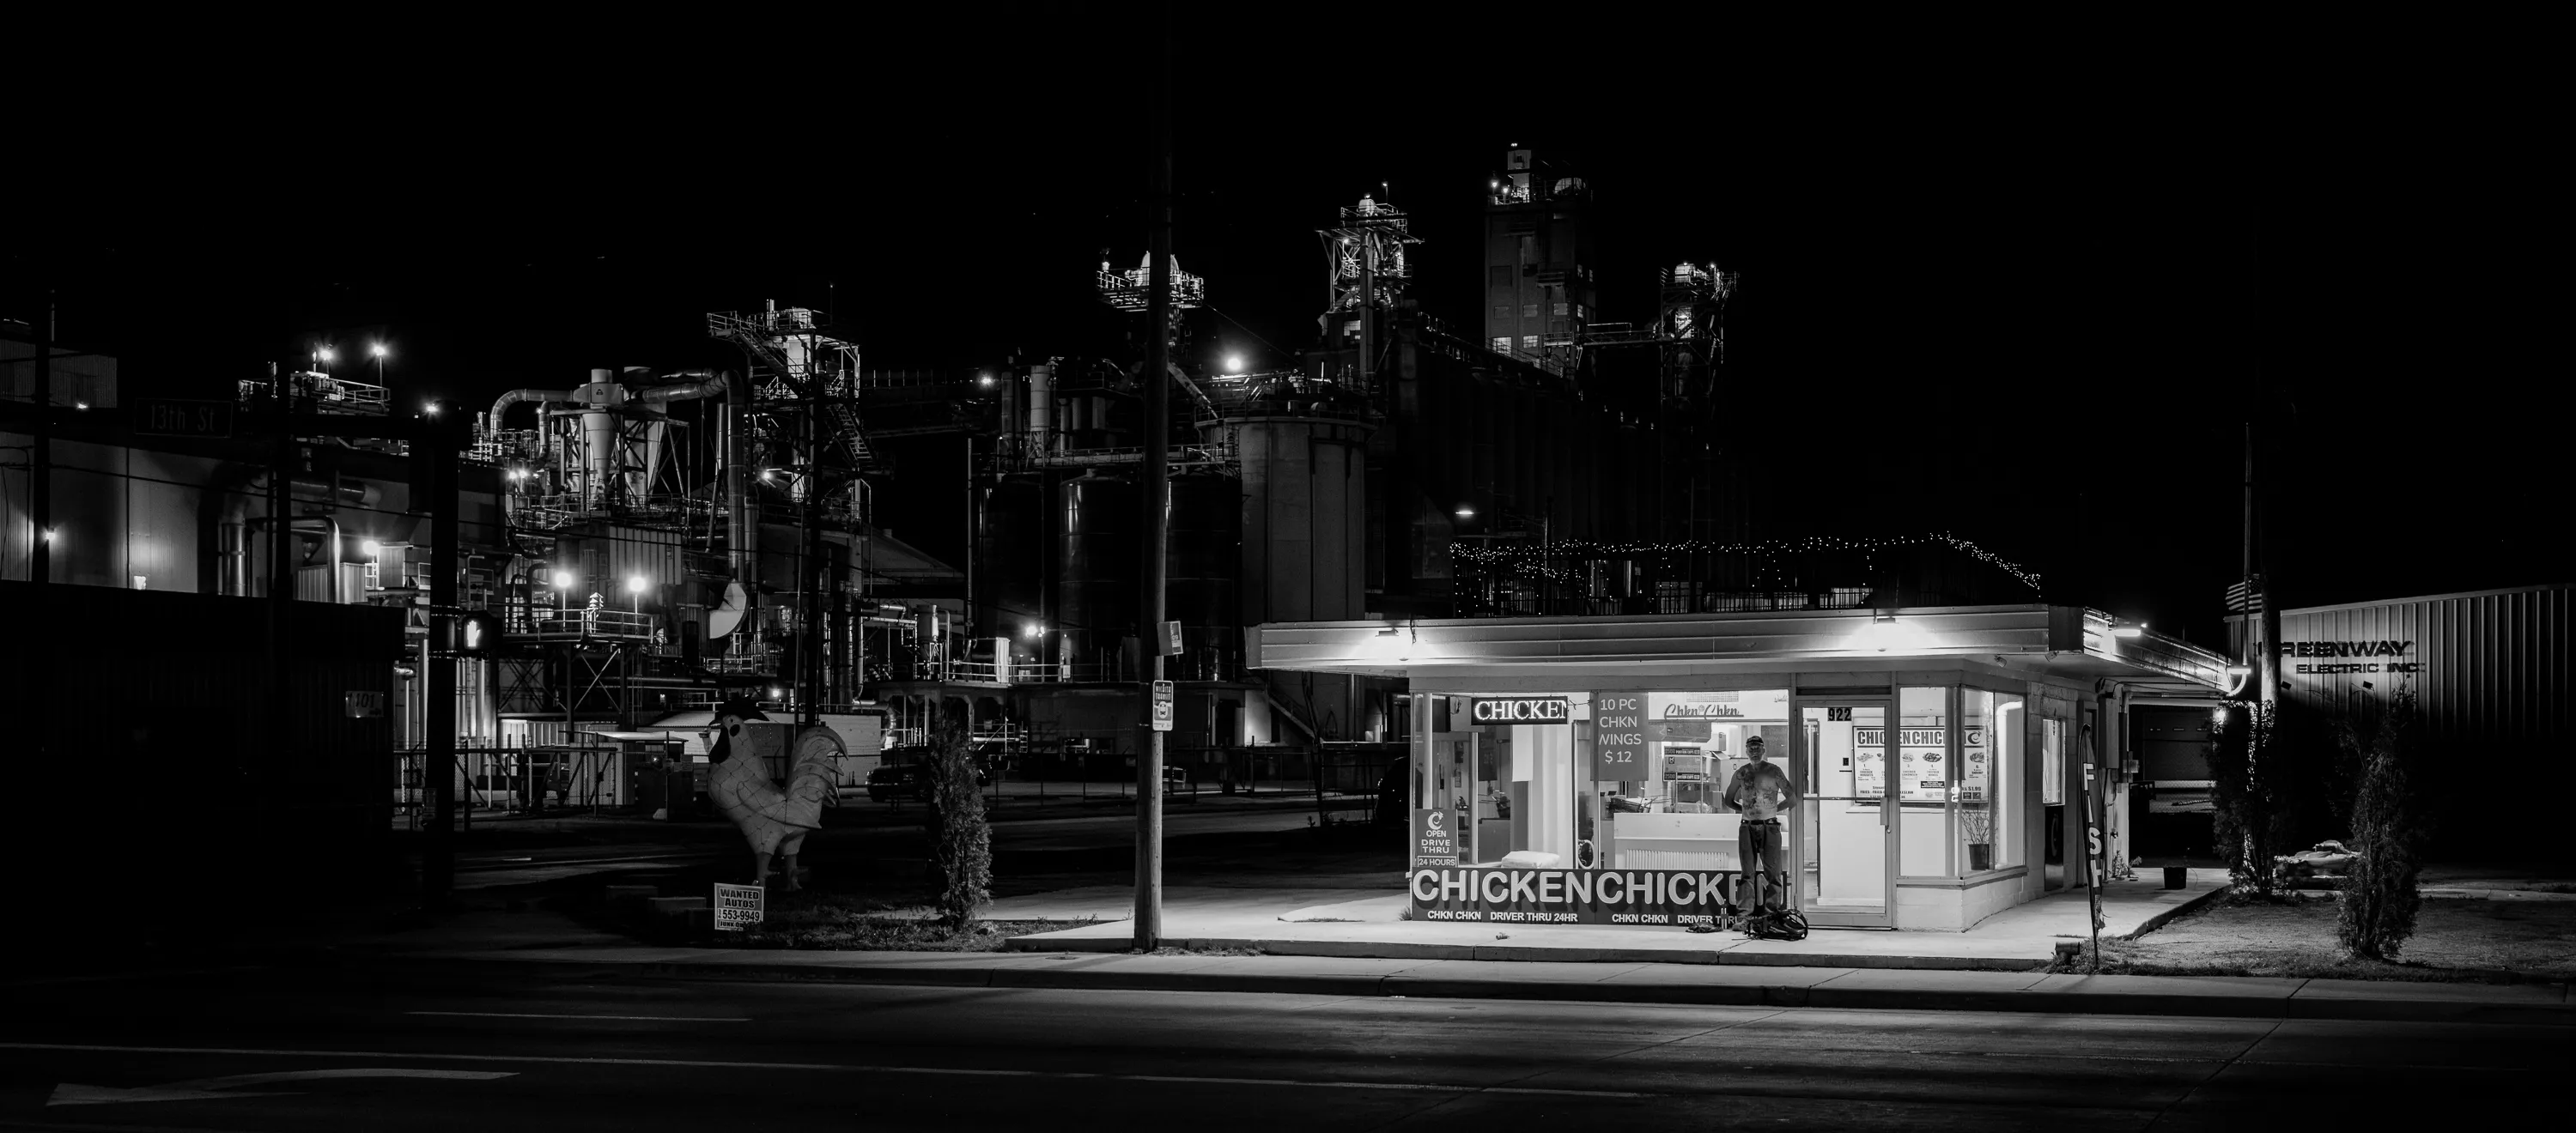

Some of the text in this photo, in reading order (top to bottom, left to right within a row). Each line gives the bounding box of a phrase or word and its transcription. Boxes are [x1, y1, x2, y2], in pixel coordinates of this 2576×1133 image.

[150, 403, 216, 432] 13th St
[2258, 641, 2411, 657] REENWAY
[2296, 663, 2379, 675] ELECTRIC
[1601, 699, 1637, 711] 10 PC
[1828, 707, 1851, 721] 922
[1600, 716, 1637, 728] CHKN
[1858, 731, 1911, 744] CHICN
[1912, 731, 1966, 744] CHIC
[1605, 749, 1632, 764] $ 12
[720, 888, 759, 900] WANTED
[725, 898, 755, 908] AUTOS
[722, 910, 760, 922] 553-9949
[1427, 910, 1578, 922] CHKN CHKN DRIVER THRU 24HR
[1612, 913, 1639, 924] CHKN
[1641, 913, 1668, 924] CHKN
[1716, 915, 1738, 924] TR
